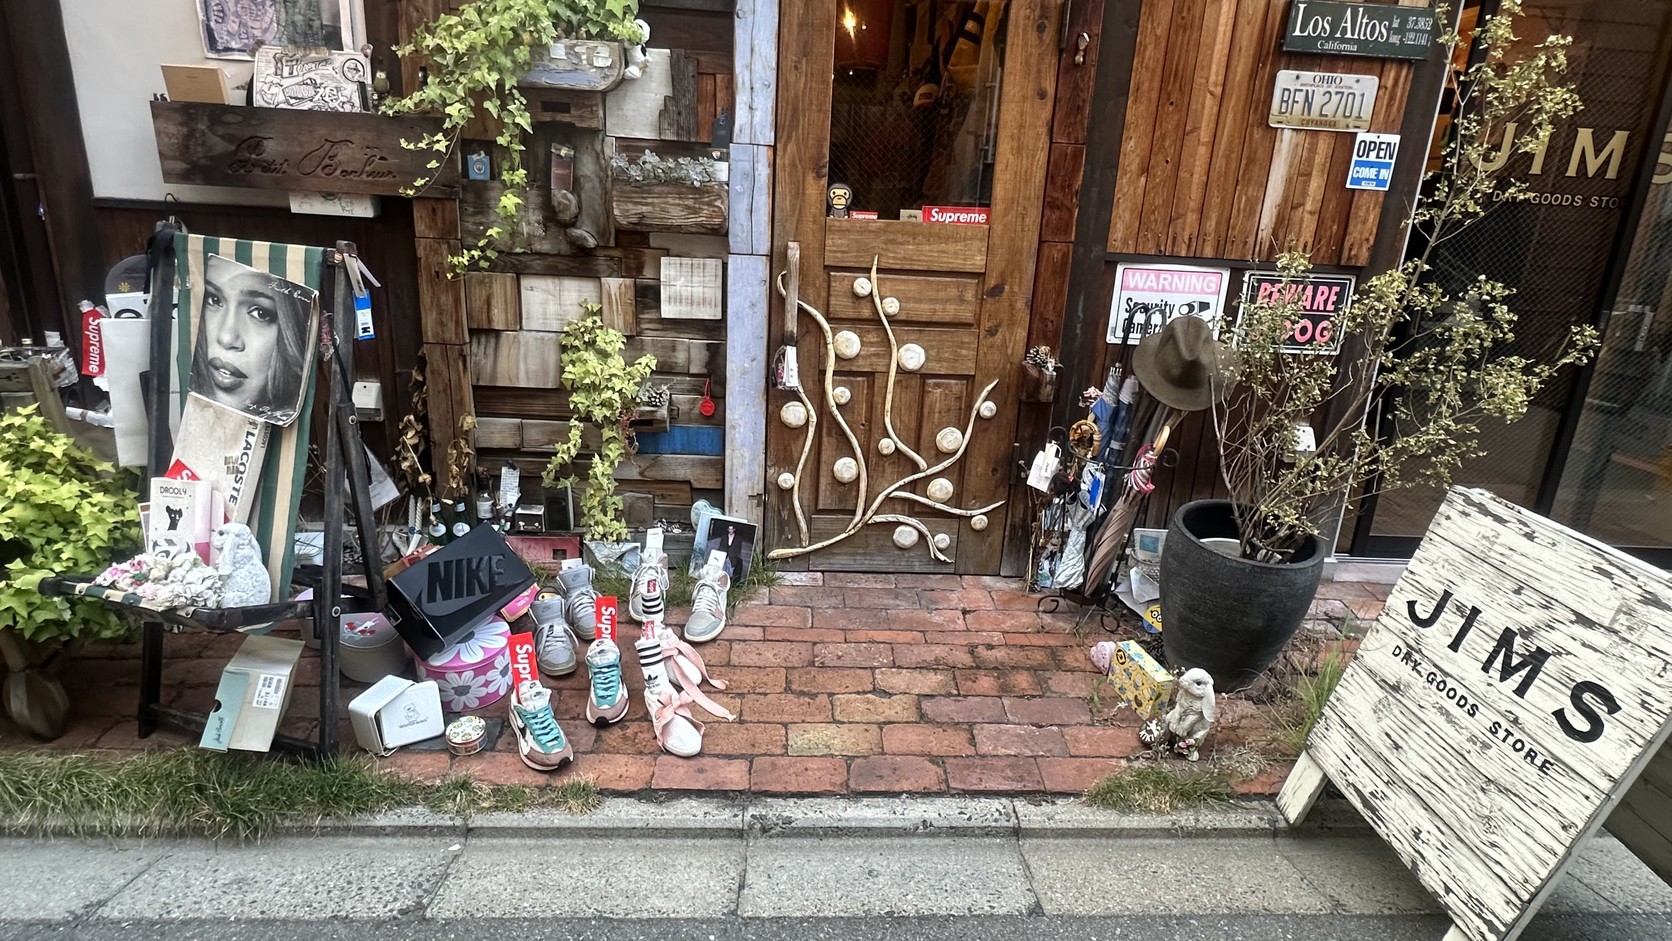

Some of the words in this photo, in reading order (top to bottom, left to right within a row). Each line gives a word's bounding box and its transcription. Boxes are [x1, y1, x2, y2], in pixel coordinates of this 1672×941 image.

[1292, 3, 1332, 37] Los
[1335, 6, 1390, 42] Altos
[1317, 40, 1358, 51] California
[1312, 74, 1343, 86] OHIO
[1278, 87, 1316, 117] BFN
[1319, 90, 1366, 120] 2701
[1356, 139, 1397, 161] OPEN
[1352, 166, 1379, 180] COME
[1378, 168, 1390, 180] IN
[1530, 193, 1583, 207] GOODS
[852, 211, 878, 220] Supreme
[930, 208, 987, 224] Supreme
[1128, 272, 1218, 293] WARNING
[84, 316, 101, 373] Supreme
[260, 424, 271, 449] LACOSTE
[229, 430, 256, 506] LACOSTE
[426, 554, 506, 604] NIKE
[1406, 589, 1622, 744] JIMS
[1391, 645, 1424, 677] DRY
[1426, 671, 1480, 718] GOODS
[1489, 720, 1555, 776] STORE
